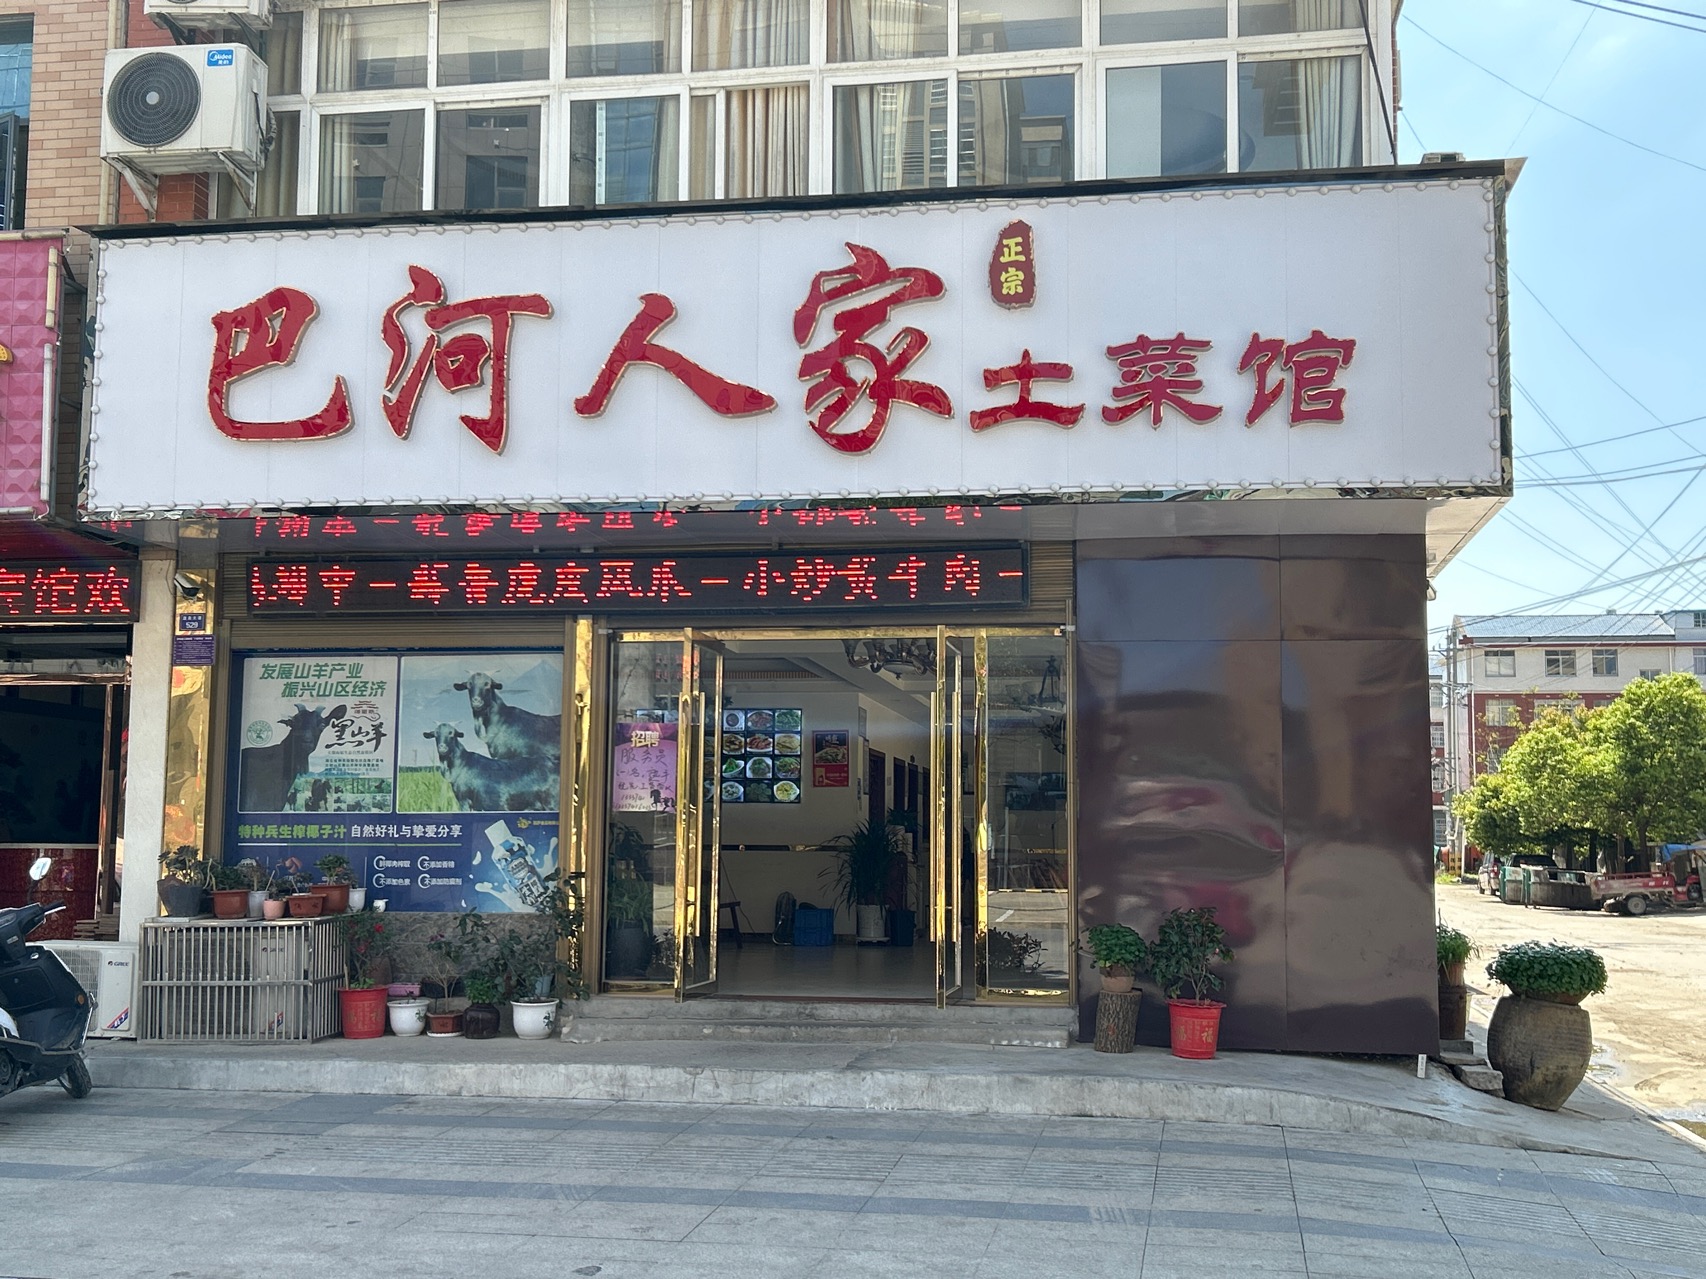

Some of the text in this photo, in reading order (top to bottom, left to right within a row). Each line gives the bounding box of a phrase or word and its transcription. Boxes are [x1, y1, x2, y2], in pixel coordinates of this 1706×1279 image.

[1000, 236, 1026, 296] 正宗
[208, 243, 1356, 456] 巴河人家 土菜馆
[185, 621, 199, 629] 529
[259, 663, 364, 680] 发展山羊产业
[281, 681, 388, 698] 振兴山区经济
[324, 719, 388, 752] 黑山羊
[631, 730, 661, 747] 招聘
[620, 747, 669, 768] 服务员
[238, 824, 463, 839] 特种兵生榨椰子汁 自然好礼与挚爱分享
